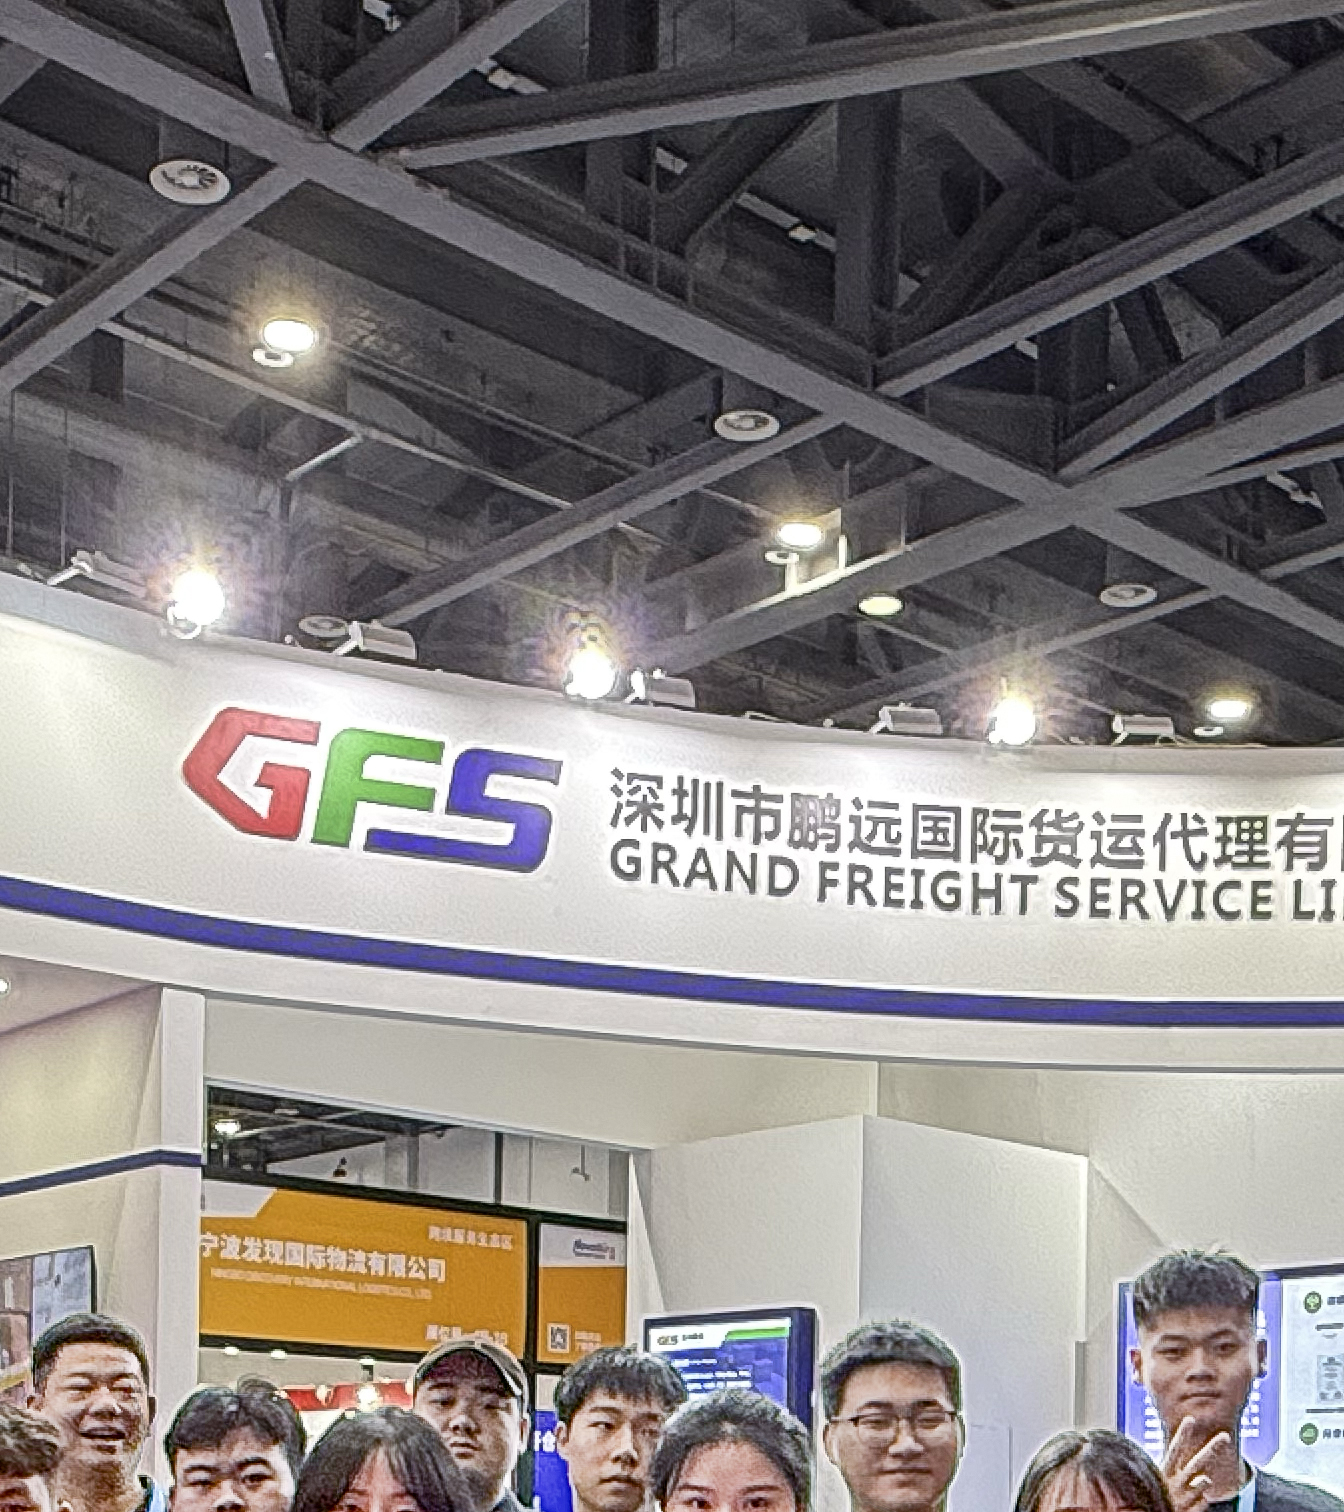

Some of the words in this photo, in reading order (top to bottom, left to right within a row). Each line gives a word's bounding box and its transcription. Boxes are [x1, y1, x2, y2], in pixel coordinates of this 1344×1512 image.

[181, 705, 563, 873] GFS
[610, 838, 800, 898] GRAND
[816, 861, 1037, 916] FREIGHT
[1054, 876, 1272, 922] SERVICE
[200, 1231, 446, 1283] 宁波发现国际物流有限公司
